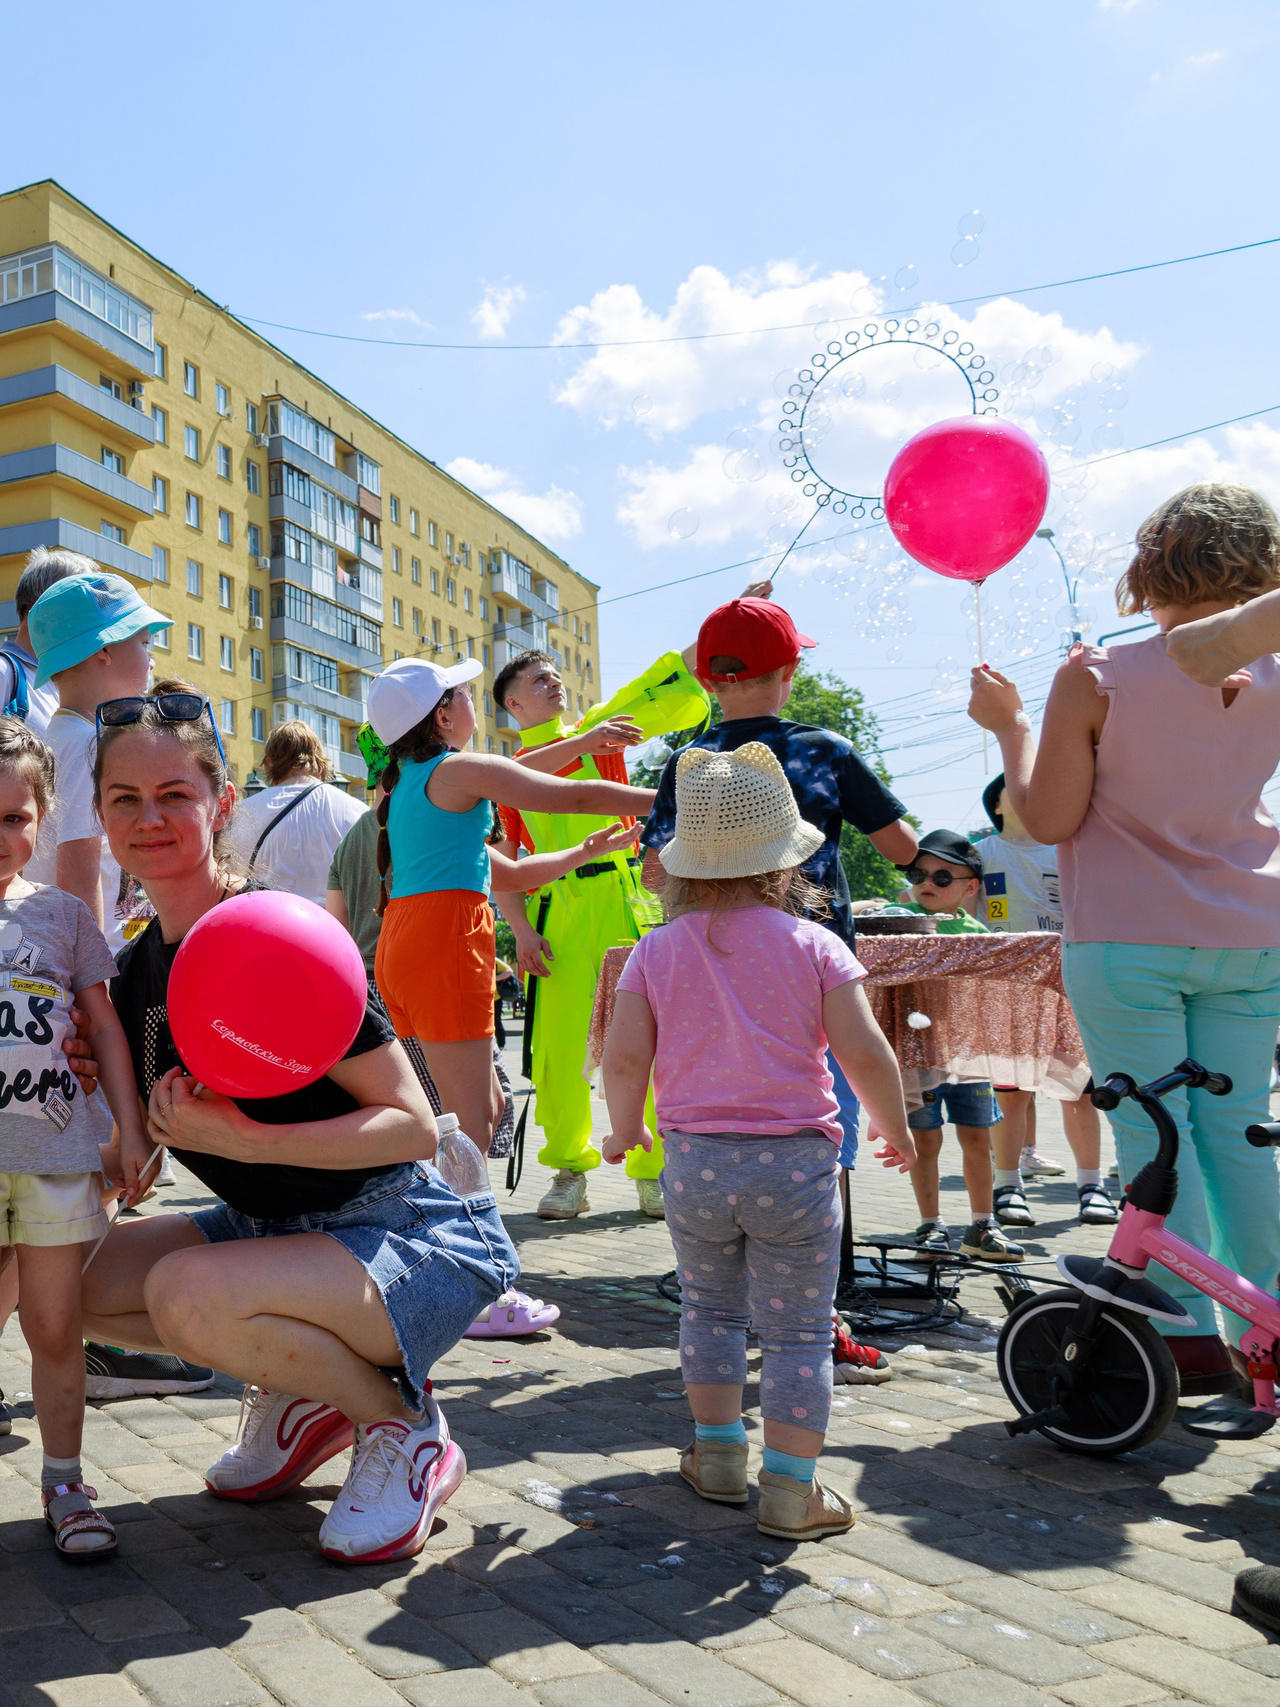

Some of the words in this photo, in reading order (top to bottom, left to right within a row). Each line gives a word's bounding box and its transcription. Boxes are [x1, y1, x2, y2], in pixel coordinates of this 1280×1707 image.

[990, 901, 1003, 918] 2
[212, 1019, 283, 1064] Сормовские
[284, 1059, 313, 1074] Зори
[1175, 1262, 1257, 1314] KREISS
